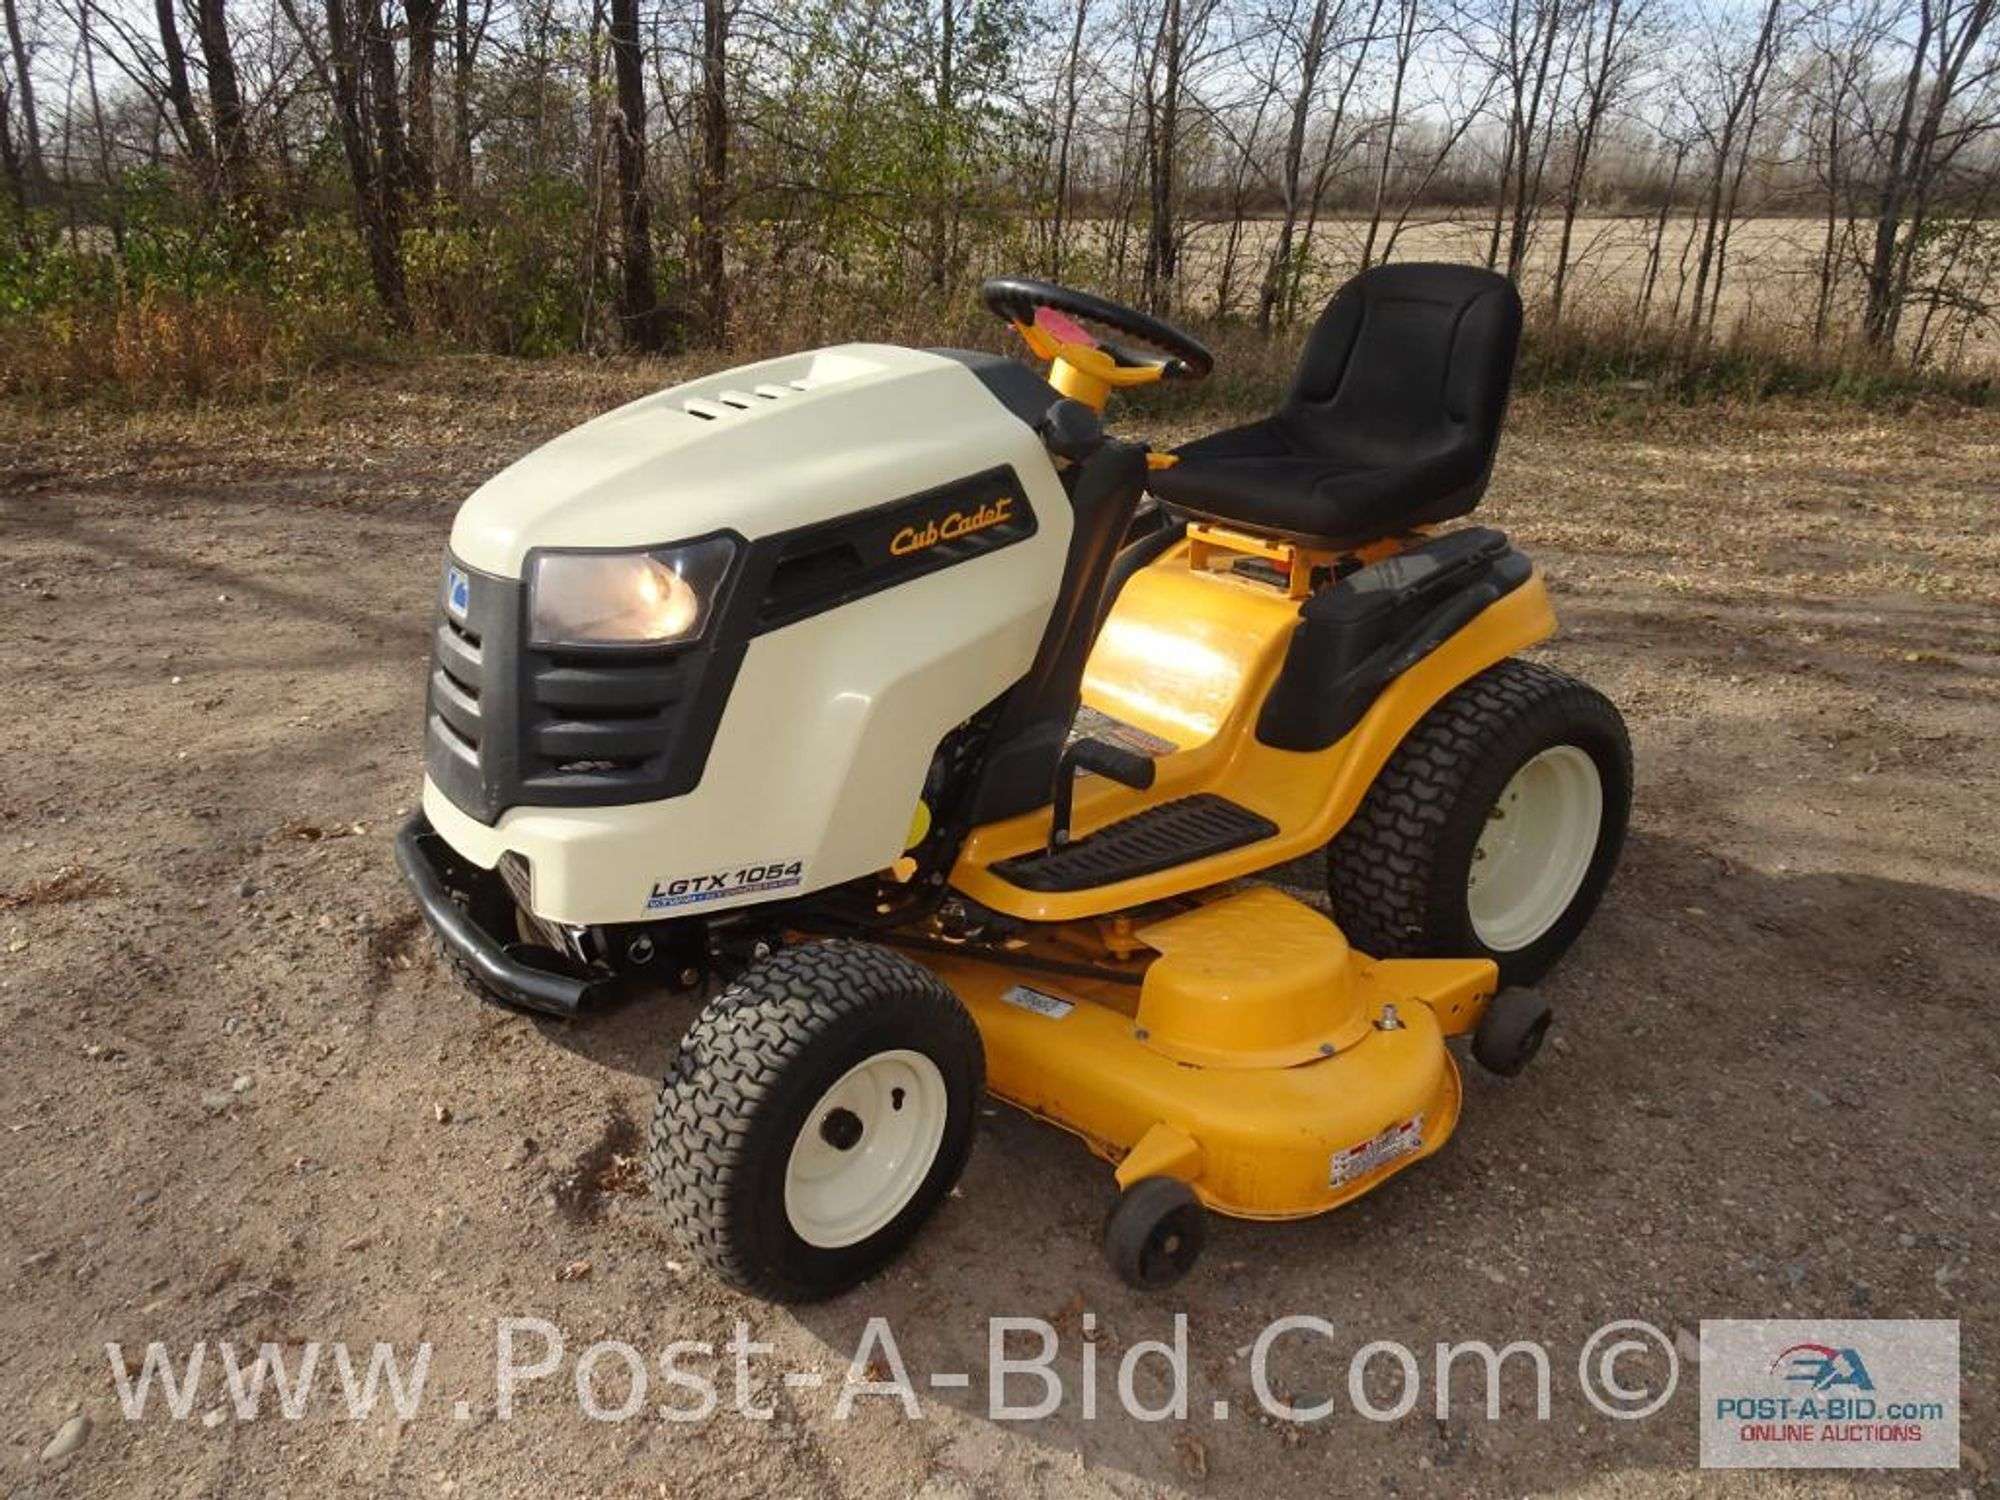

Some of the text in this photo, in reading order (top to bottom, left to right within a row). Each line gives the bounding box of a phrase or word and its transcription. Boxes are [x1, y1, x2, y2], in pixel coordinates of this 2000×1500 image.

[889, 497, 1013, 556] Cub Cadet
[651, 872, 729, 898] LGTX
[735, 861, 803, 885] 1054
